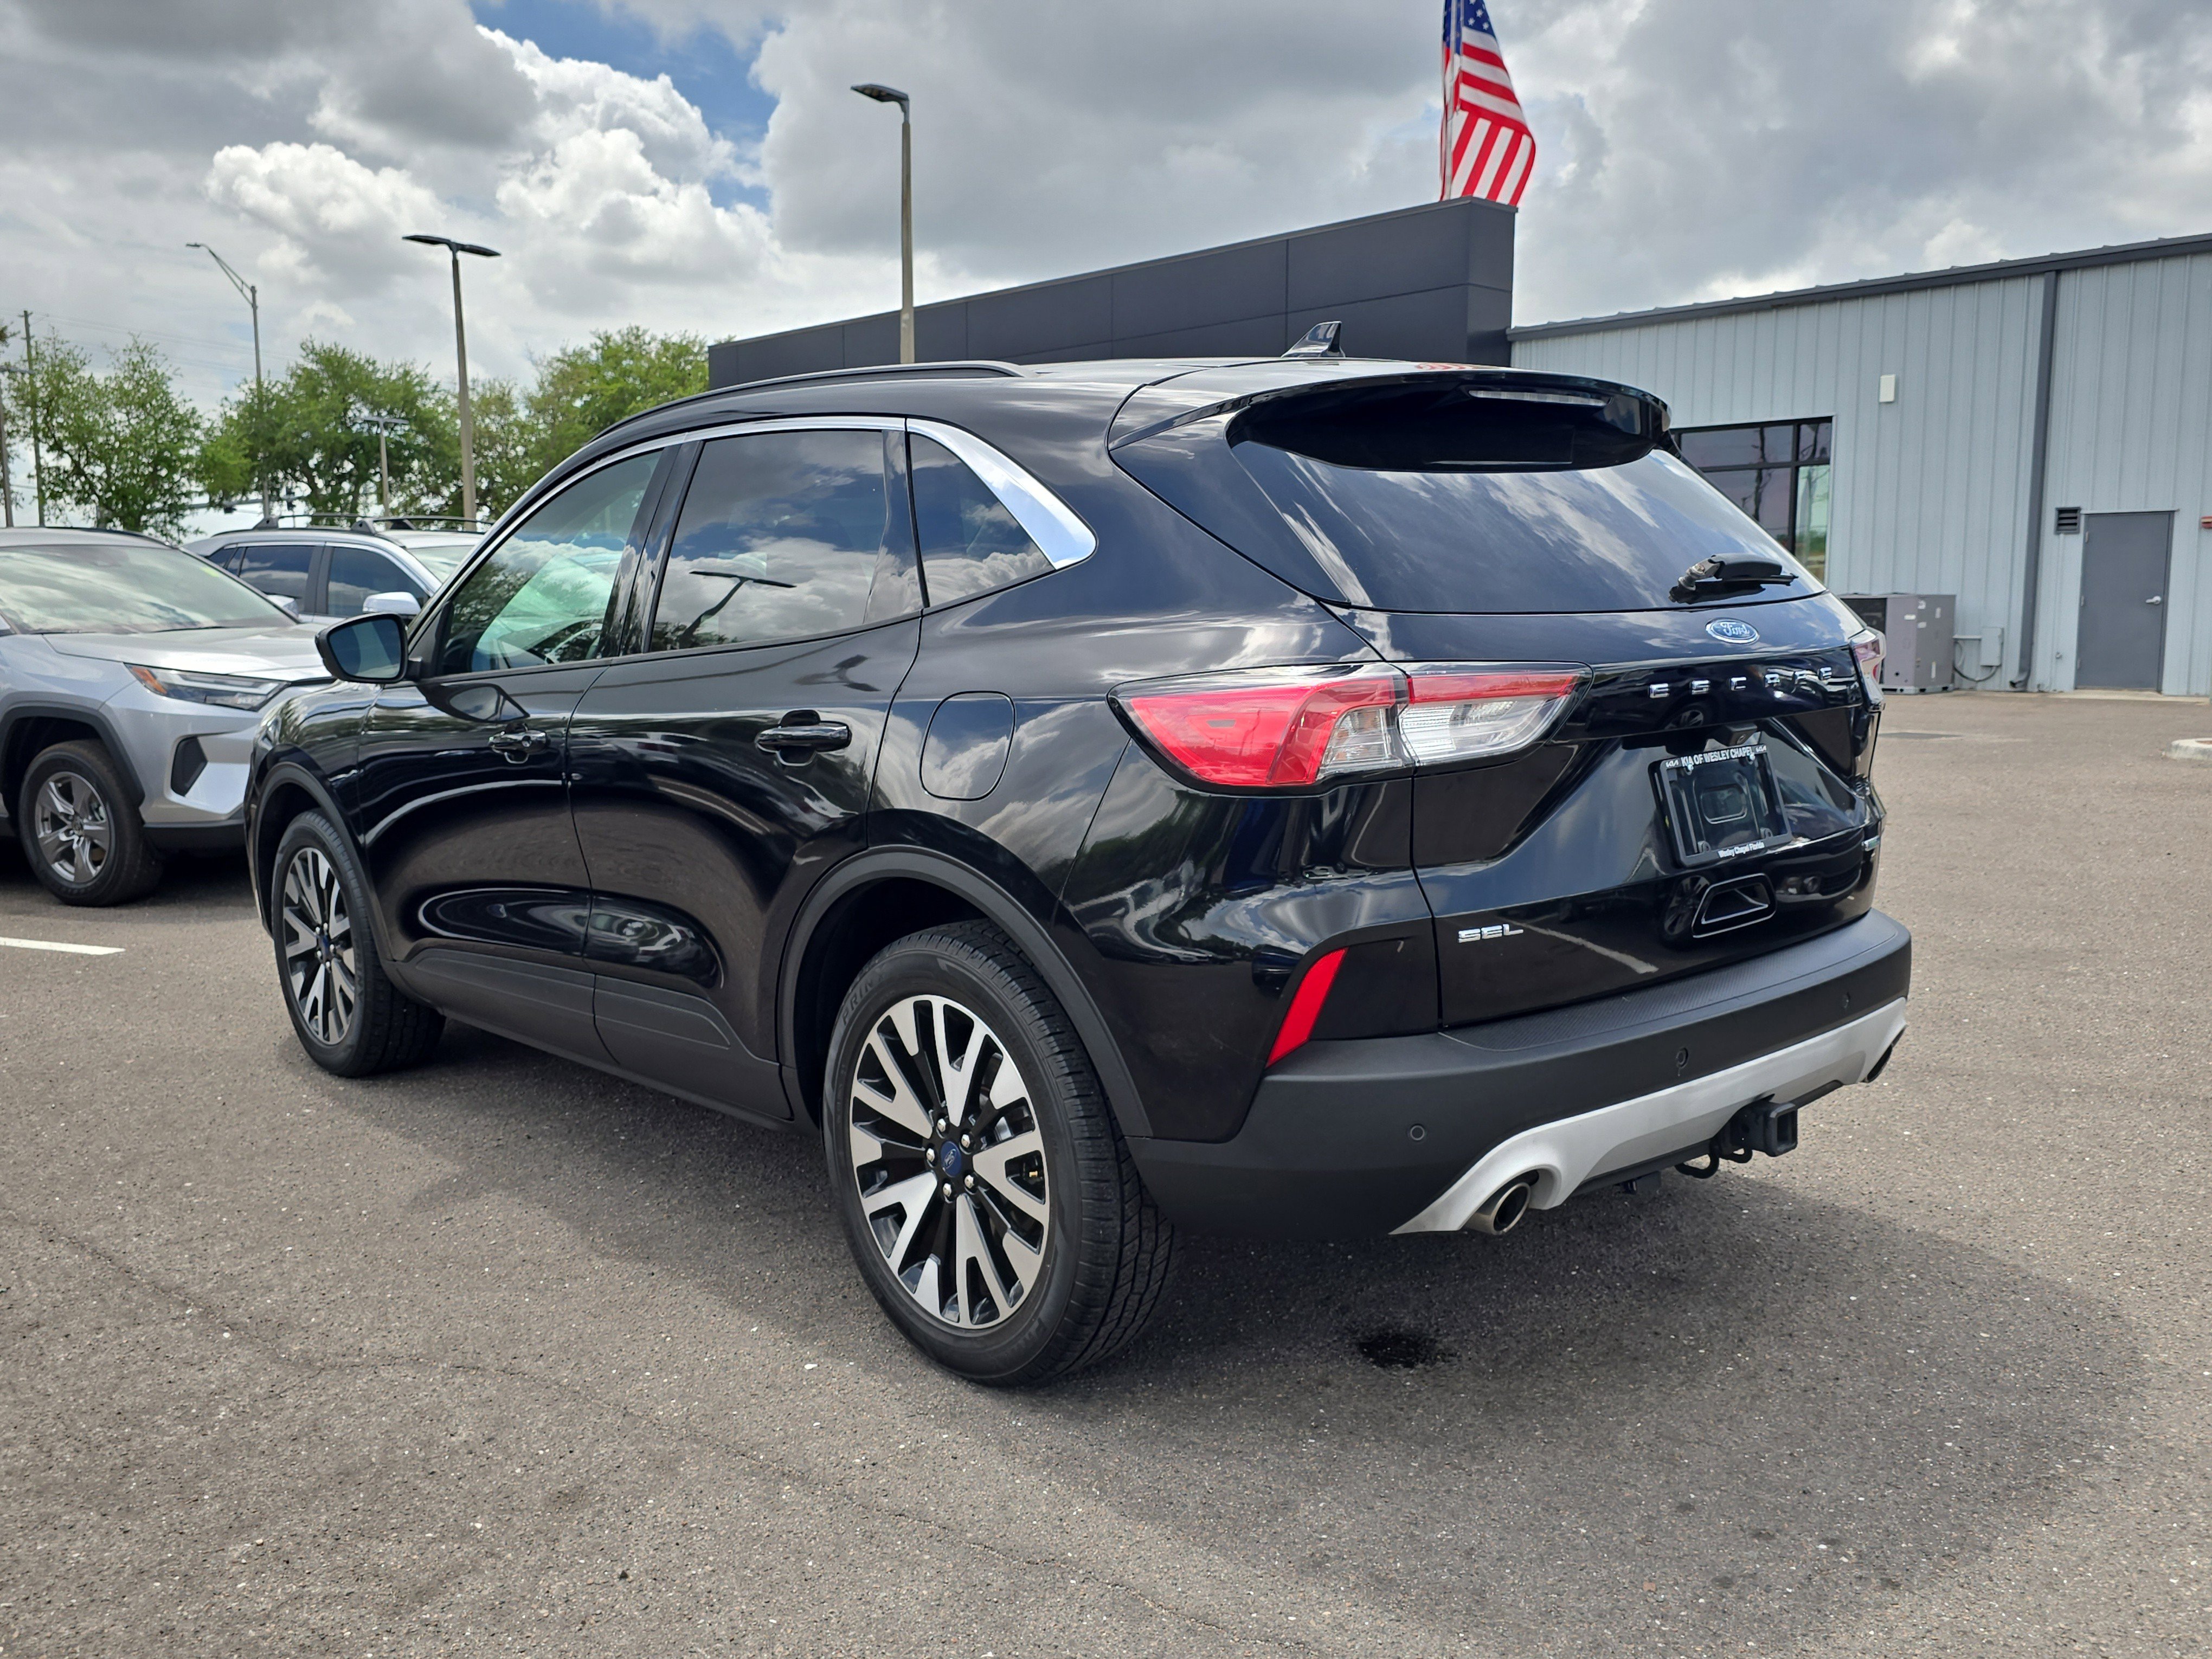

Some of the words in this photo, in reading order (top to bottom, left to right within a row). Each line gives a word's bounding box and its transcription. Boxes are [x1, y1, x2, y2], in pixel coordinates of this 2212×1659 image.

[1720, 622, 1750, 636] Ford
[1681, 755, 1694, 767] KIA
[1693, 754, 1703, 765] OF
[1703, 749, 1730, 763] WESLEY
[1730, 746, 1754, 758] CHAPEL
[1458, 923, 1524, 943] SEL
